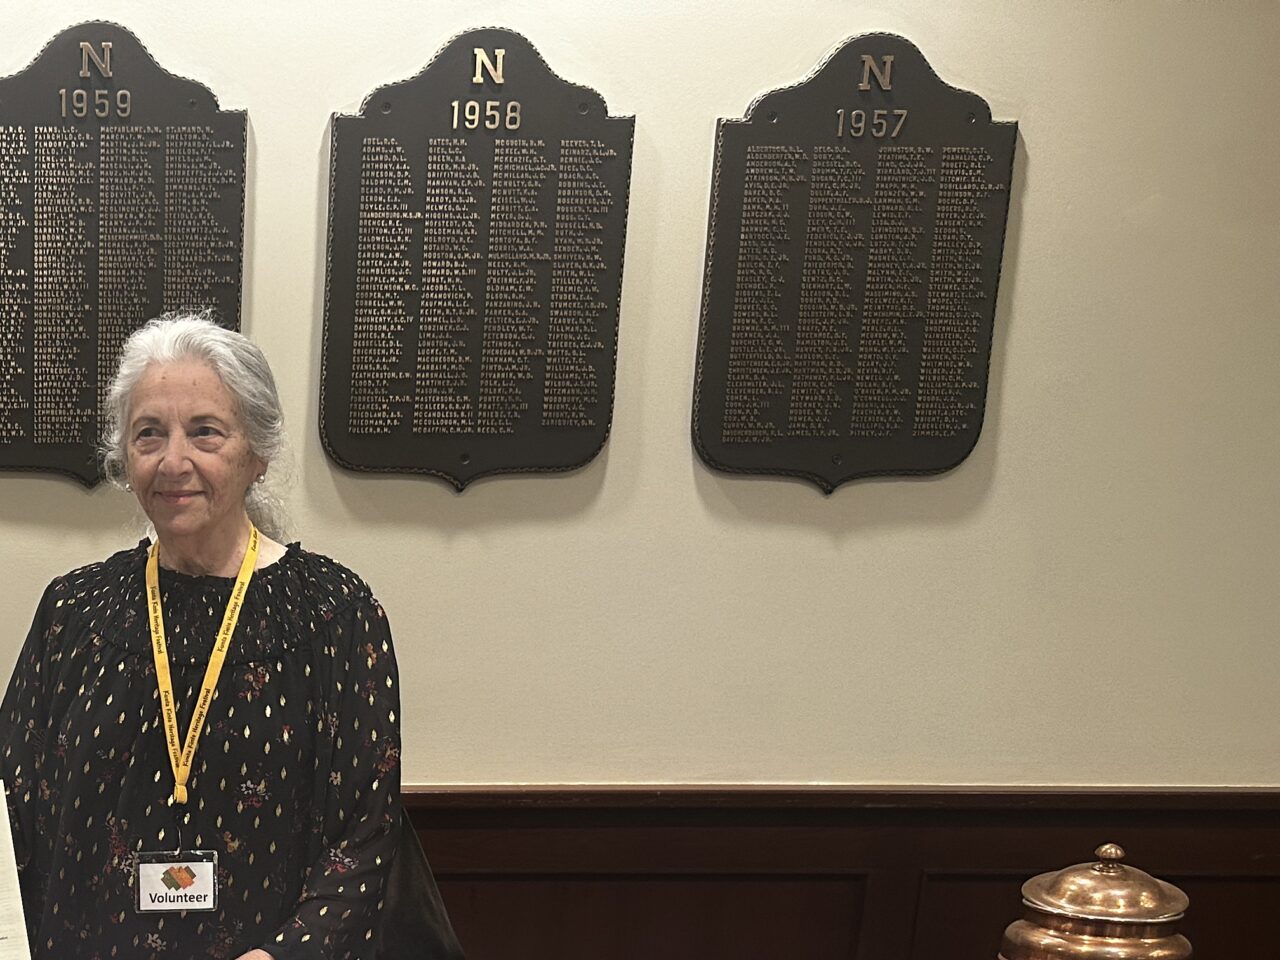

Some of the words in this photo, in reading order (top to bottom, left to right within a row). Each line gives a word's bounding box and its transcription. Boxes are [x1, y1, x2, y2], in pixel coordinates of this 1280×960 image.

[79, 41, 112, 78] N
[472, 48, 505, 84] N
[858, 54, 895, 91] N
[59, 88, 132, 118] 1959
[451, 100, 521, 130] 1958
[836, 109, 909, 139] 1957
[149, 892, 208, 903] Volunteer
